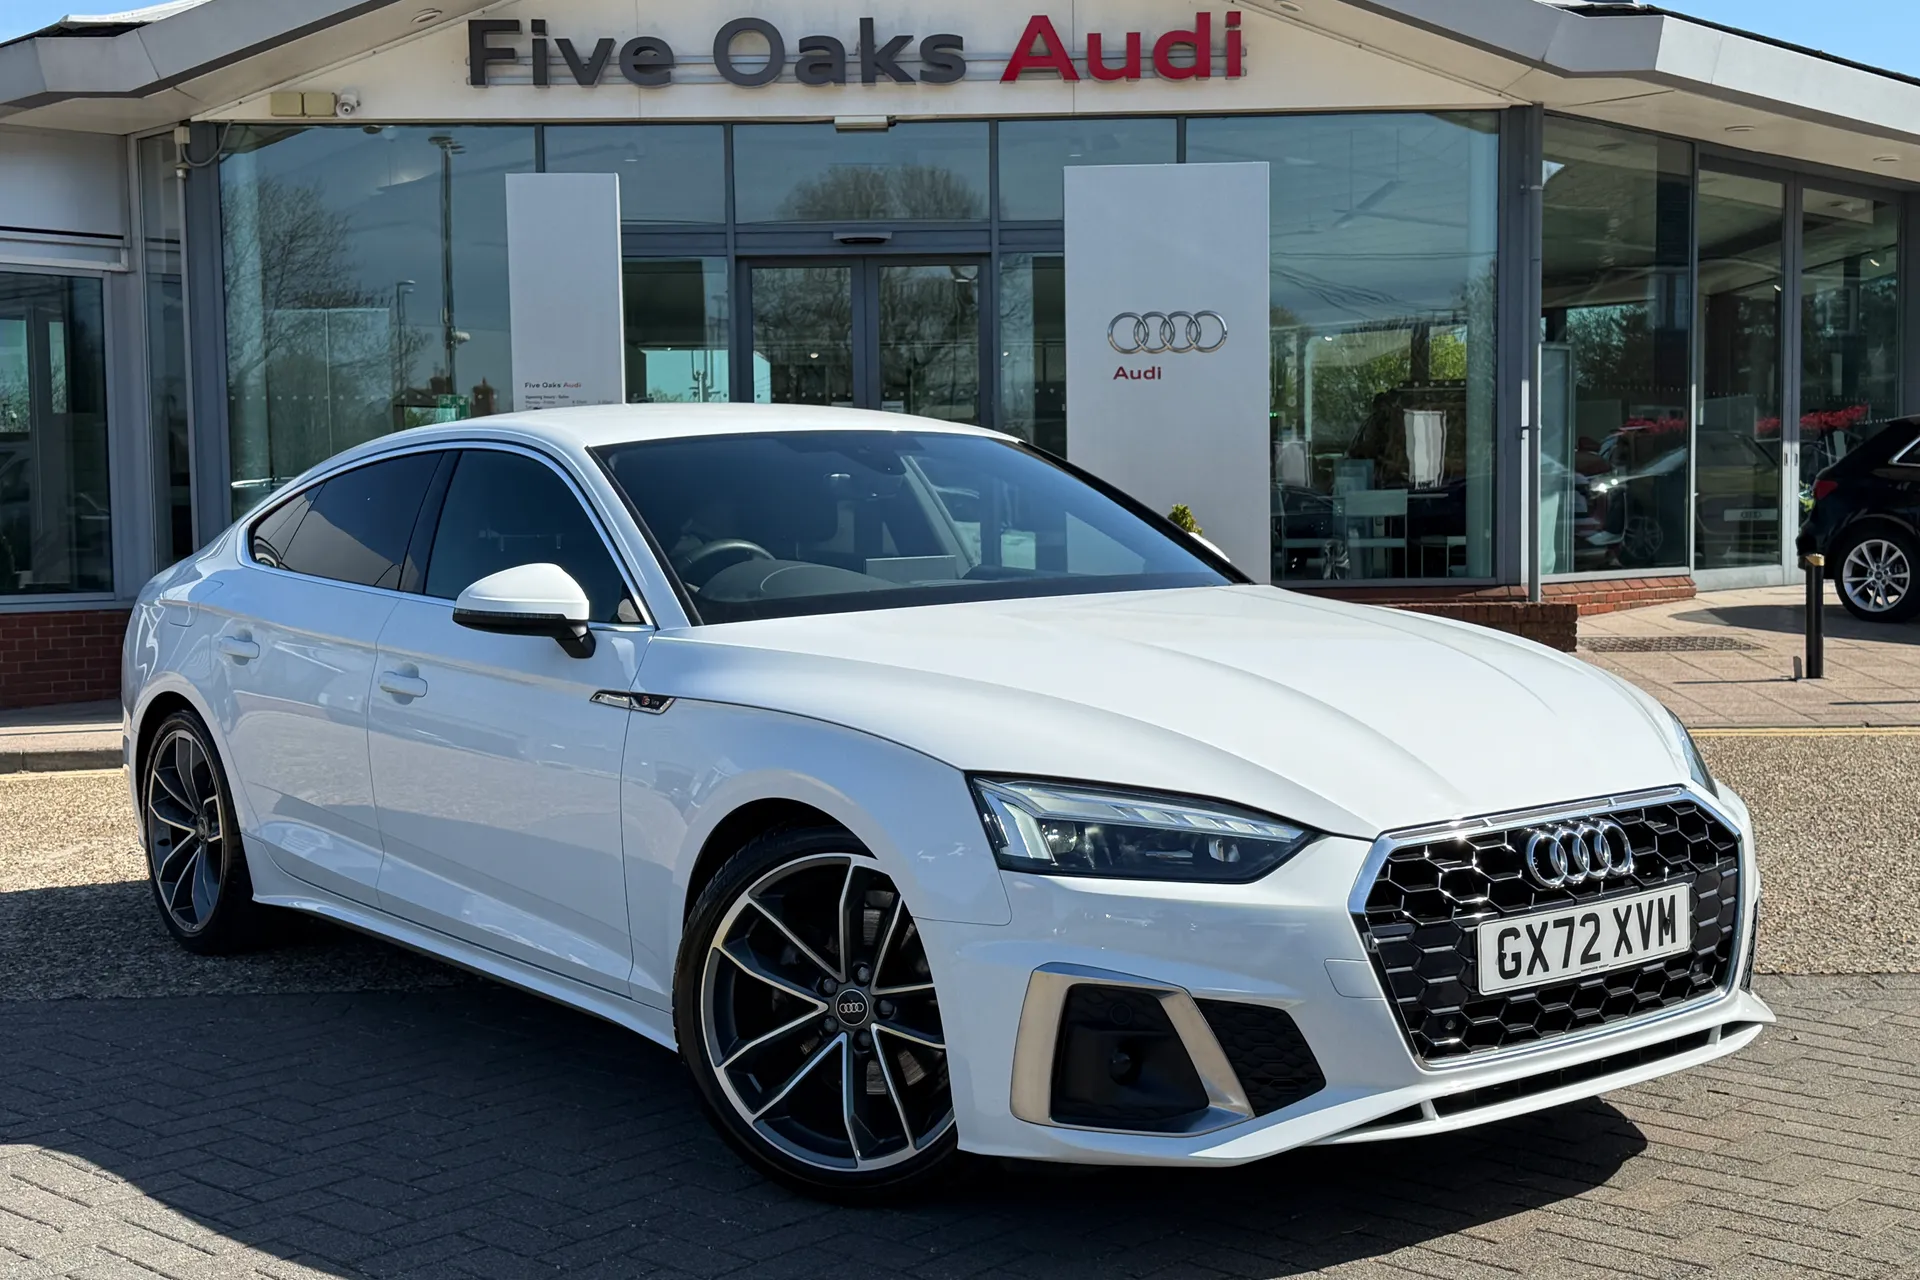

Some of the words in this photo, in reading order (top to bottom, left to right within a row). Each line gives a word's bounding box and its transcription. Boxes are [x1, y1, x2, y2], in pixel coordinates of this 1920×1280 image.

[468, 19, 674, 88] Five
[713, 17, 967, 87] Oaks
[1000, 12, 1244, 83] Audi
[1113, 366, 1162, 380] Audi
[1497, 912, 1601, 980] GX72
[1612, 894, 1677, 958] XVM
